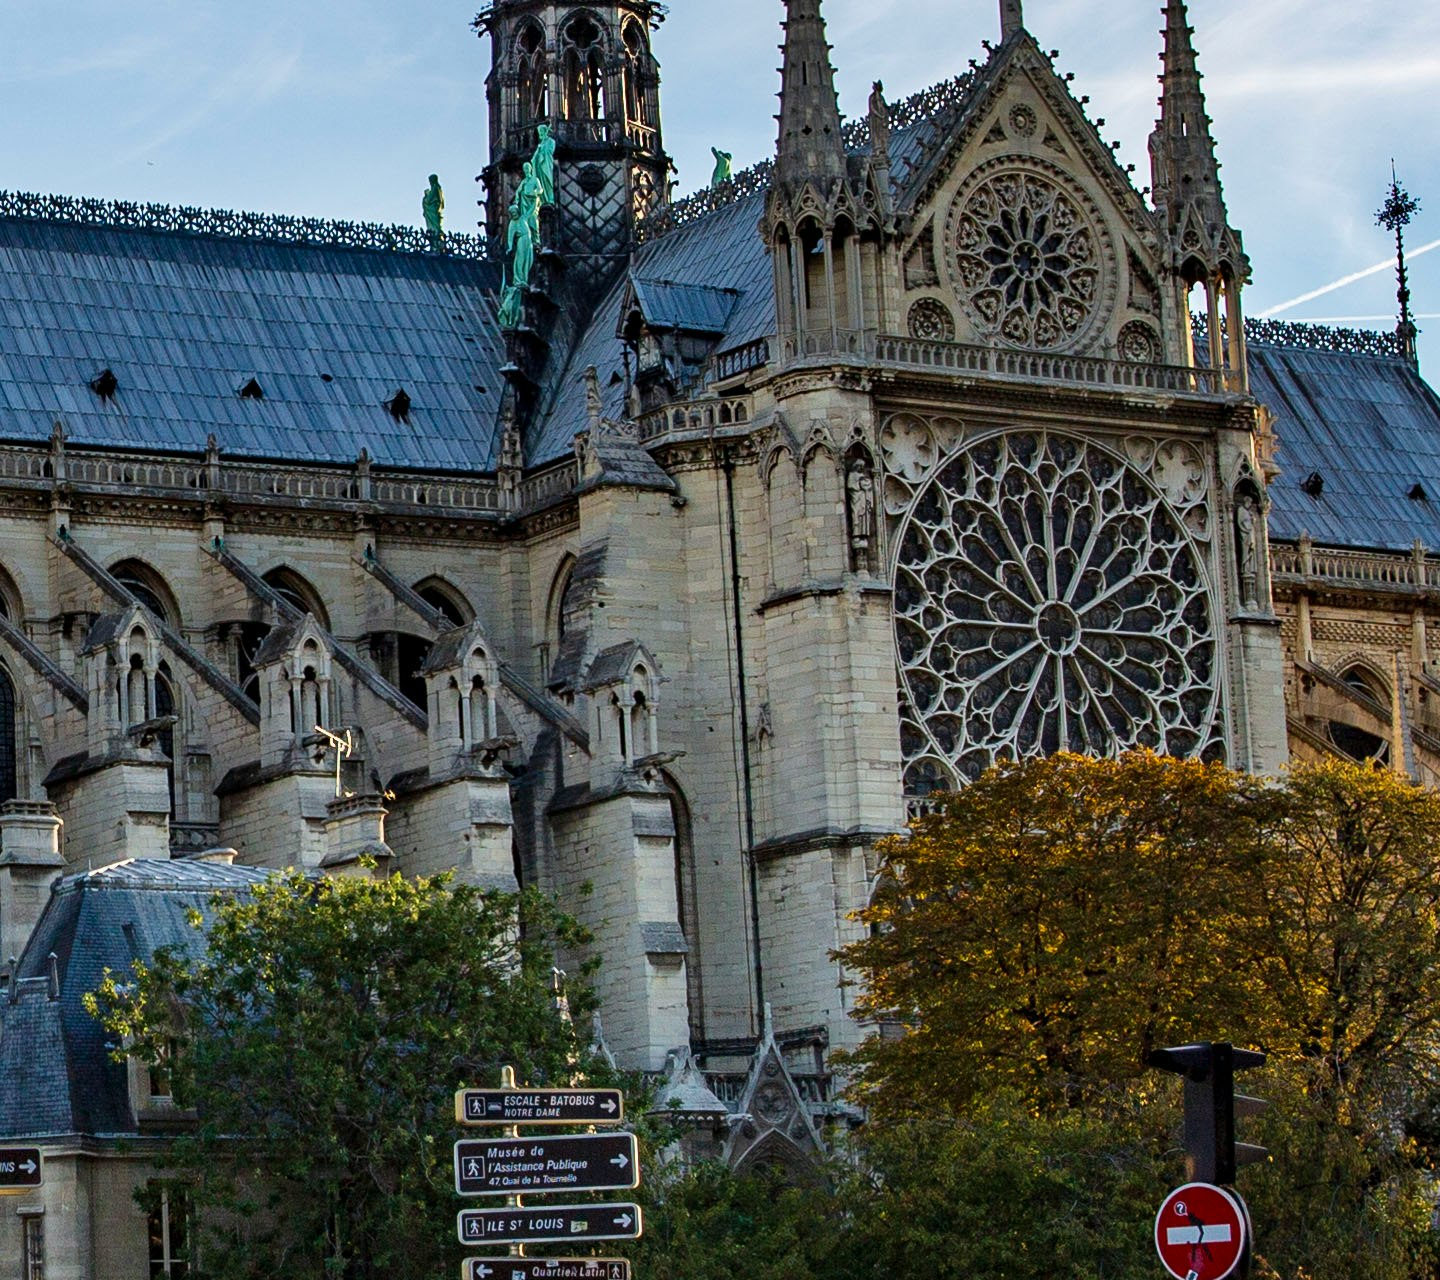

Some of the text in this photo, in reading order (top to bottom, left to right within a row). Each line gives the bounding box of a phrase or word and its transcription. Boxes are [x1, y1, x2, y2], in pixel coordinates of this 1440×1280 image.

[504, 1096, 540, 1106] ESCALE
[550, 1095, 595, 1106] BATOBUS
[504, 1108, 561, 1117] NOTRE DAME
[487, 1146, 544, 1158] Musée de
[488, 1159, 588, 1173] l'Assistance Publique
[502, 1176, 520, 1186] Quai
[521, 1175, 532, 1185] de
[533, 1175, 541, 1184] la
[487, 1221, 505, 1231] ILE
[529, 1218, 564, 1231] LOUIS
[579, 1266, 605, 1277] Latin
